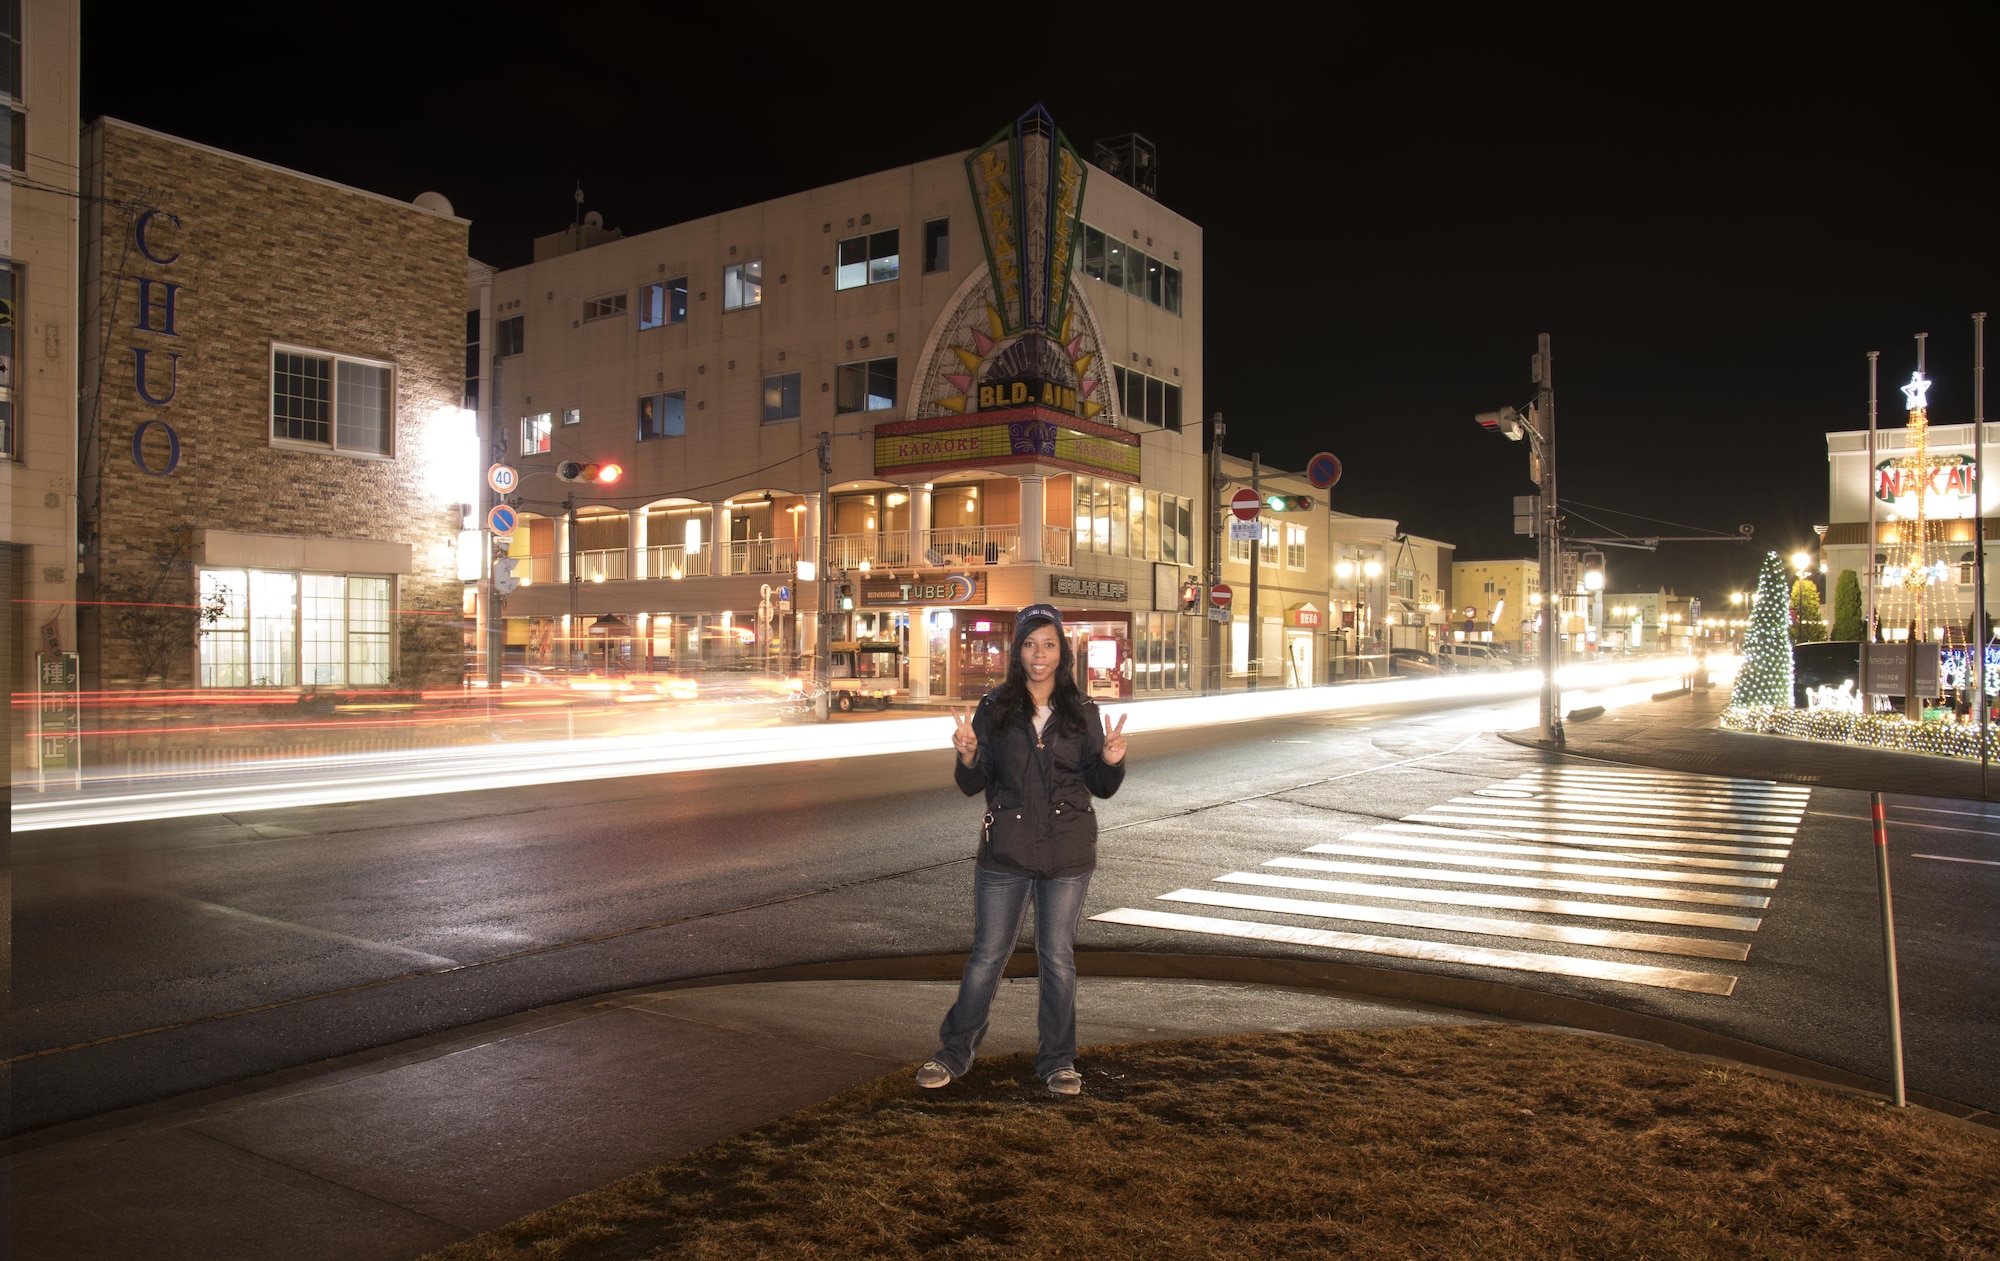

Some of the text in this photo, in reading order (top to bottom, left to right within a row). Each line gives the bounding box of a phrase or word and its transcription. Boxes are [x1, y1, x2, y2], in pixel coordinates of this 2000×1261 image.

[129, 209, 184, 477] CHUO
[980, 382, 1036, 408] BLD.
[897, 436, 981, 457] KARAOKE
[1074, 440, 1128, 466] KARAOKE
[495, 470, 511, 485] 40
[1881, 466, 1973, 499] NAKAI
[900, 583, 956, 601] TUBES
[1868, 656, 1895, 665] American
